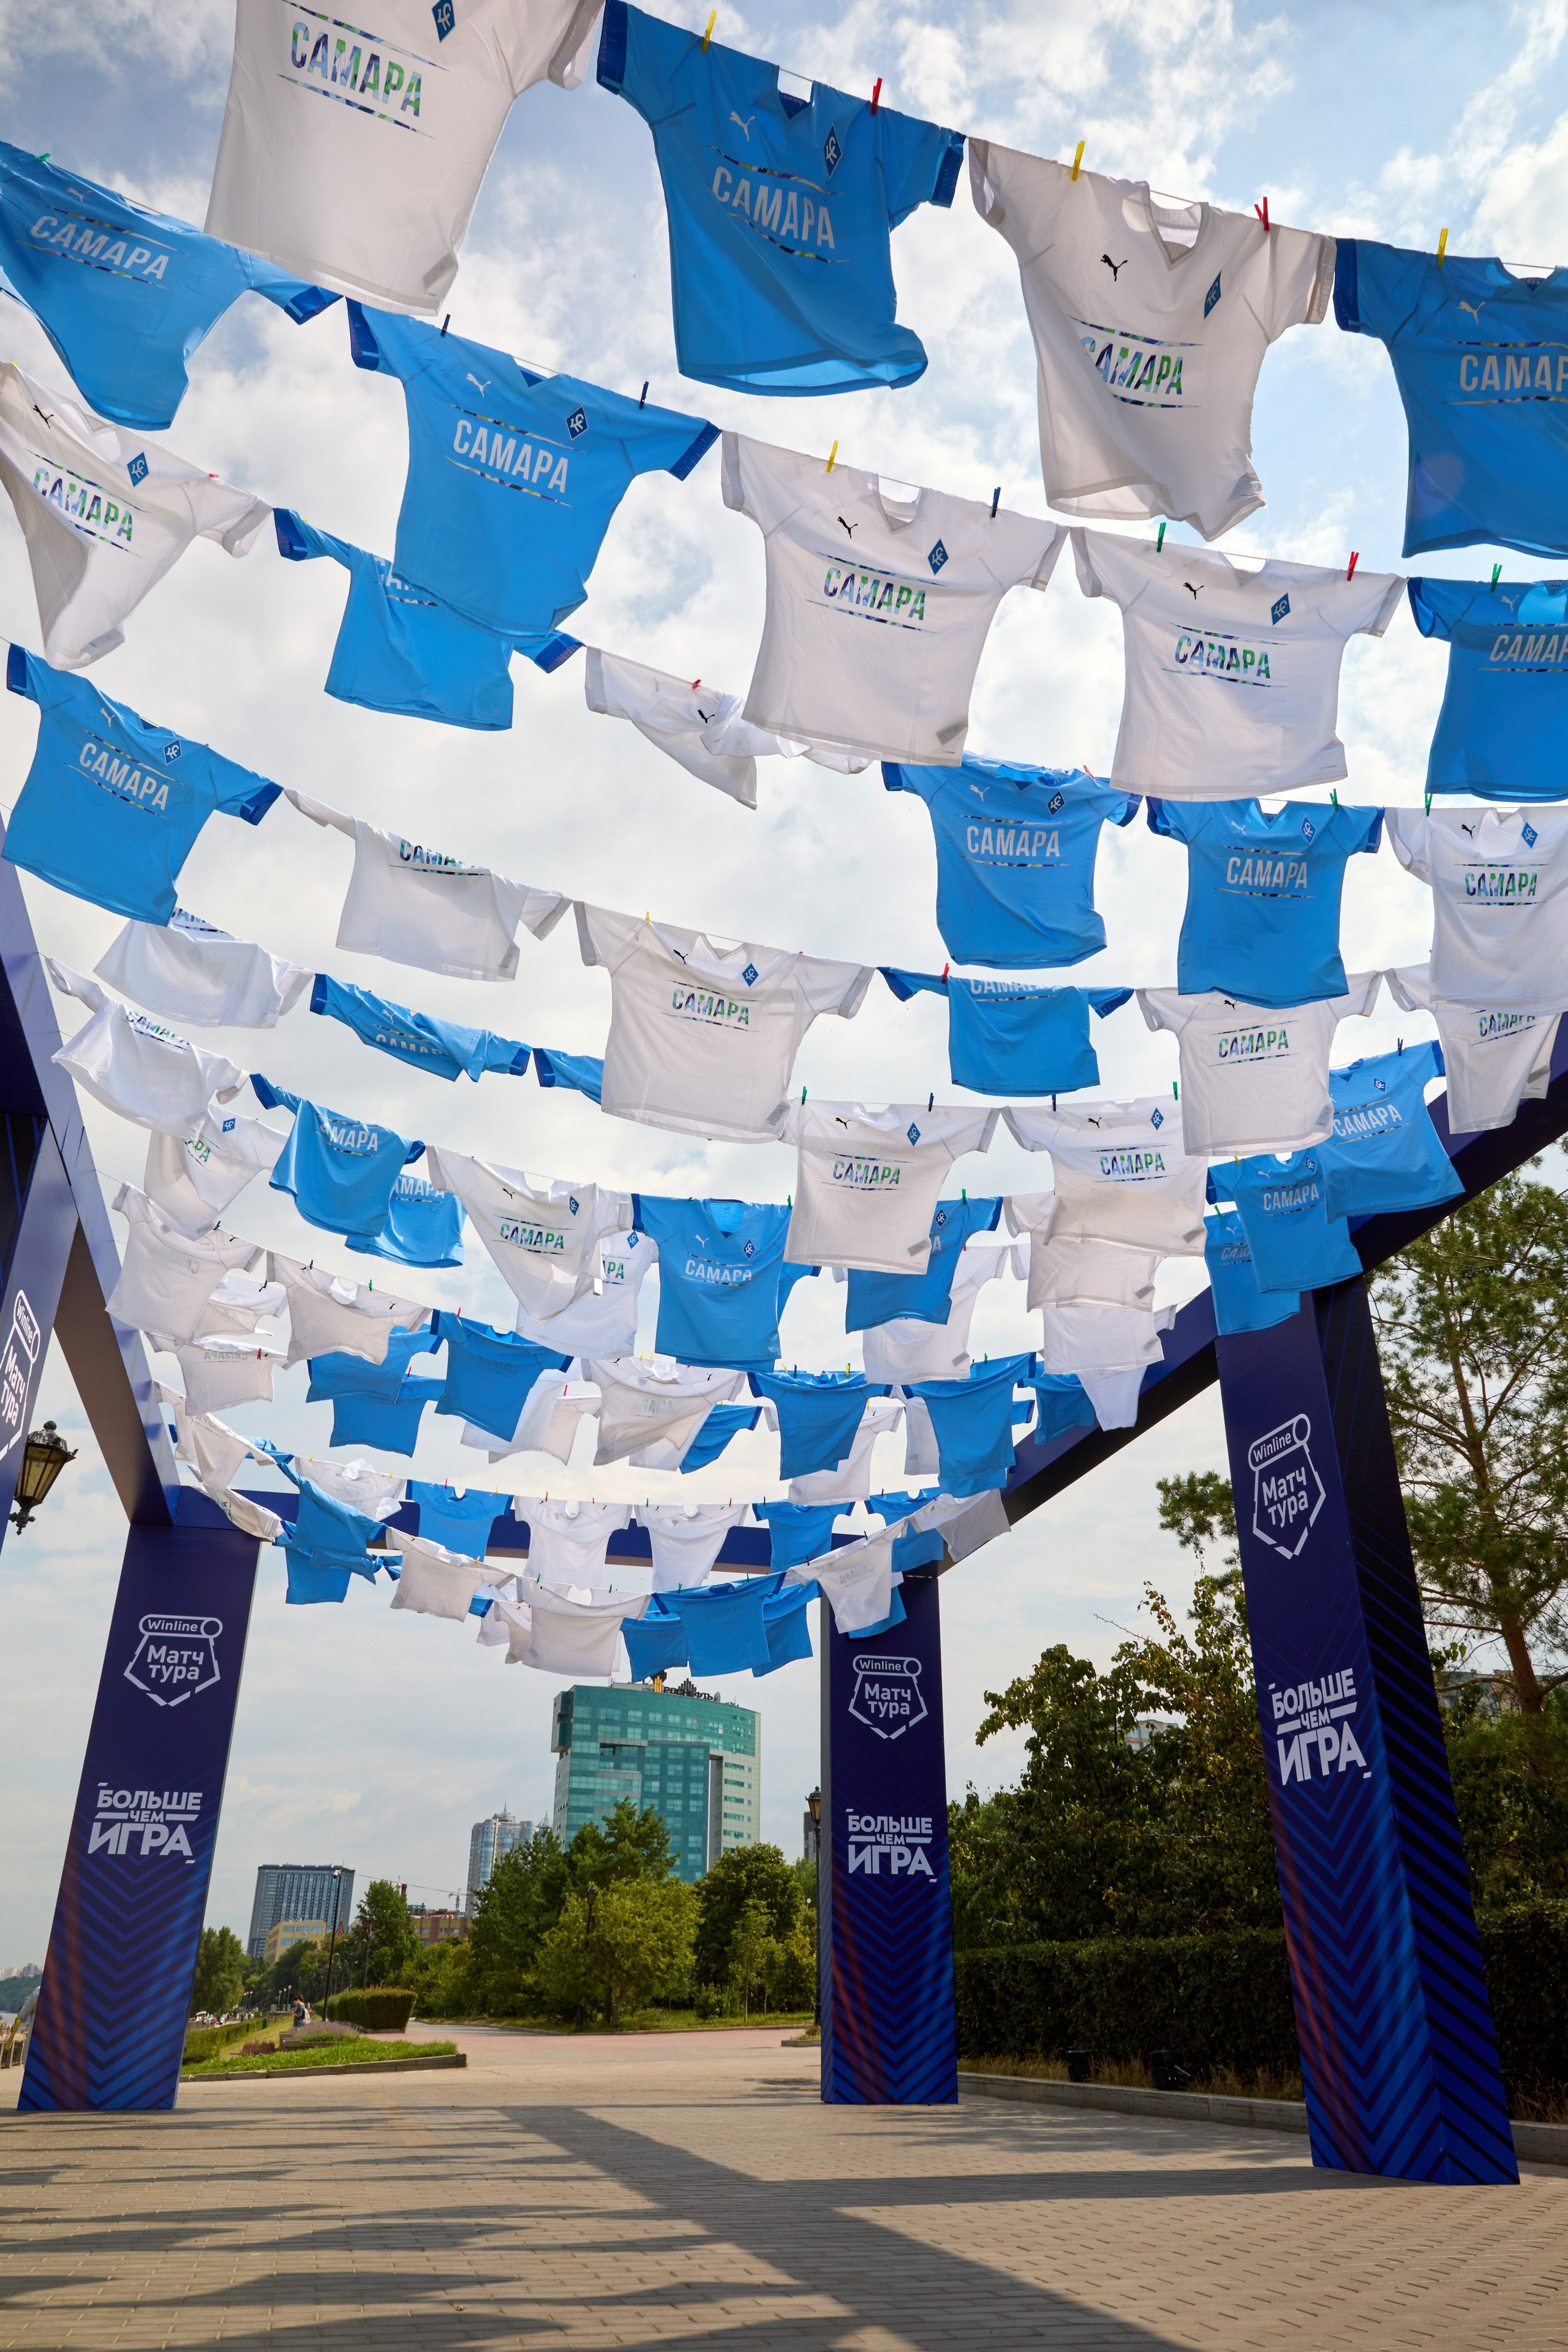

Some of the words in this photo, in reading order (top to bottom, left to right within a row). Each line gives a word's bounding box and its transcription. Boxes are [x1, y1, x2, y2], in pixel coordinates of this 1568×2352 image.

[291, 22, 423, 118] САМАРА
[712, 166, 835, 249] САМАРА
[30, 216, 171, 281] САМАРА
[453, 419, 568, 494] САМАРА
[33, 467, 134, 541] САМАРА
[823, 567, 927, 620] САМАРА
[1175, 635, 1272, 679] САМАРА
[79, 742, 170, 810] САМАРА
[967, 826, 1060, 858] САМАРА
[1227, 857, 1308, 889] САМАРА
[1465, 872, 1537, 897] САМАРА
[672, 989, 750, 1025] САМАРА
[1218, 1029, 1289, 1058] САМАРА
[1333, 1104, 1403, 1137] САМАРА
[832, 1161, 901, 1185] САМАРА
[1100, 1153, 1165, 1175] САМАРА
[1264, 1183, 1319, 1211] САМАРА
[500, 1223, 565, 1250] САМАРА
[685, 1259, 752, 1281] САМАРА
[17, 1298, 33, 1343] Winline
[5, 1345, 25, 1403] Матч
[1253, 1431, 1292, 1463] Winline
[1262, 1466, 1307, 1507] Матч
[1268, 1491, 1309, 1528] тура
[148, 1619, 198, 1632] Winline
[147, 1645, 204, 1665] Матч
[859, 1659, 902, 1671] Winline
[149, 1664, 200, 1683] тура
[865, 1683, 911, 1701] Матч
[1271, 1668, 1356, 1719] БОЛЬШЕ
[867, 1700, 910, 1718] тура
[1300, 1706, 1330, 1730] ЧЕМ
[1276, 1721, 1366, 1785] ИГРА
[97, 1789, 203, 1811] БОЛЬШЕ
[130, 1810, 164, 1822] ЧЕМ
[88, 1822, 193, 1856] ИГРА
[848, 1815, 932, 1834] БОЛЬШЕ
[876, 1834, 905, 1845] ЧЕМ
[848, 1844, 934, 1875] ИГРА
